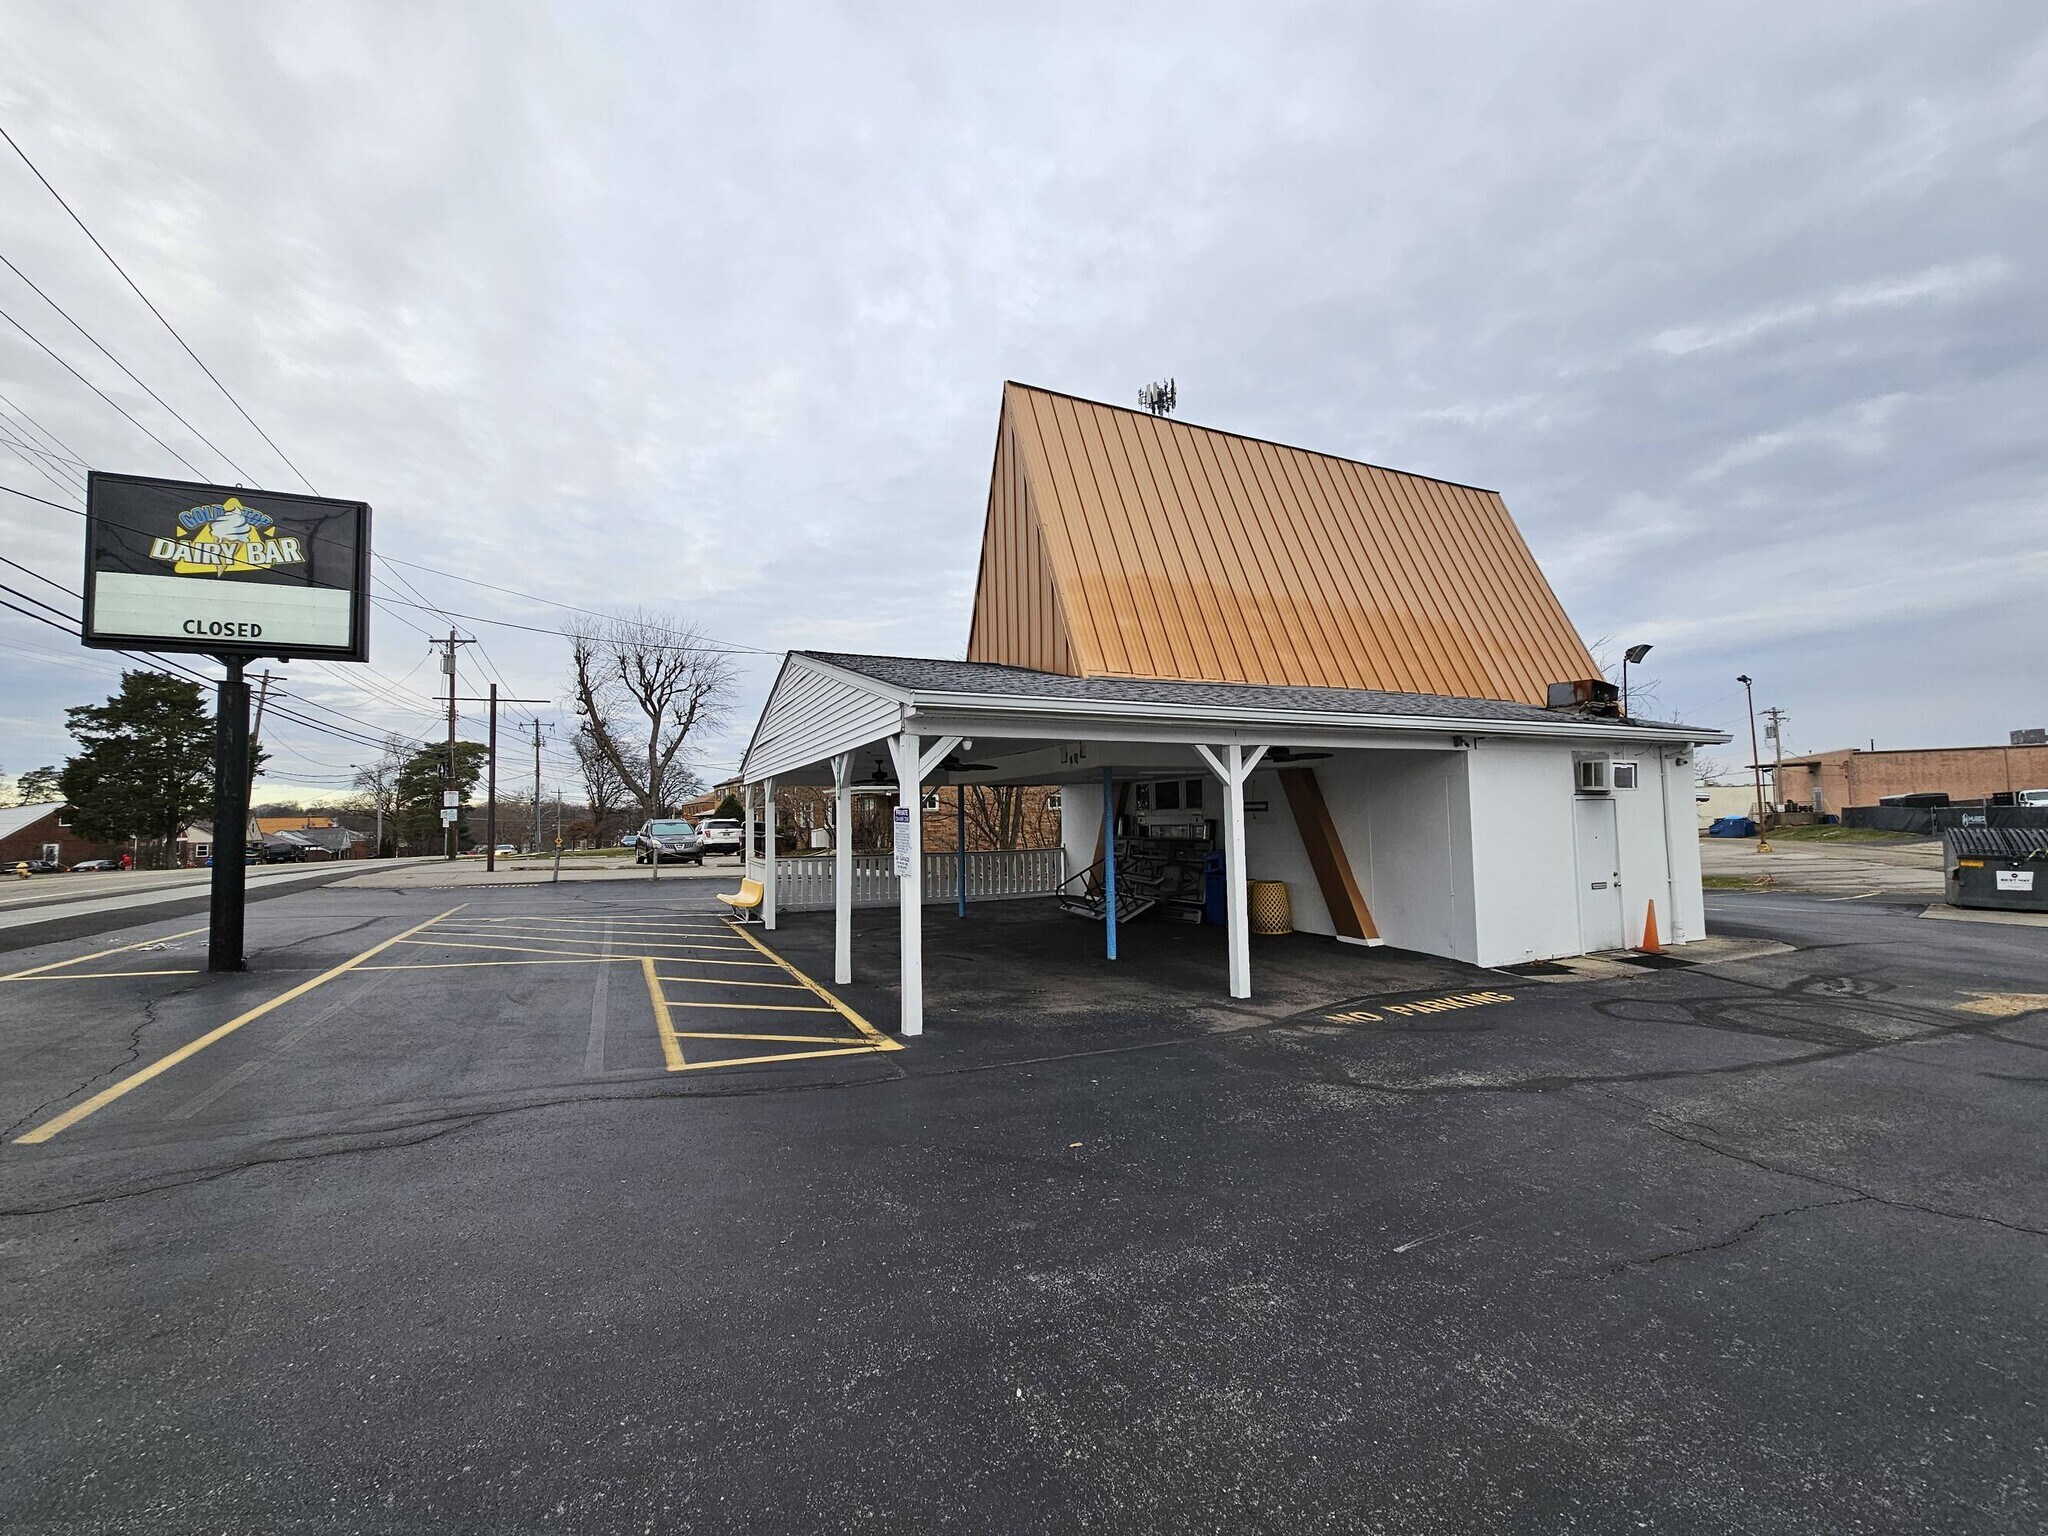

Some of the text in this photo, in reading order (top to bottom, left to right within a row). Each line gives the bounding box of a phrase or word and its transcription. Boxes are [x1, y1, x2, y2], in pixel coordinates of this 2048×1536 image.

[241, 506, 273, 529] TOP
[150, 536, 306, 566] DAIRY BAR
[182, 619, 262, 638] CLOSED
[1324, 991, 1516, 1025] NO PARKING
